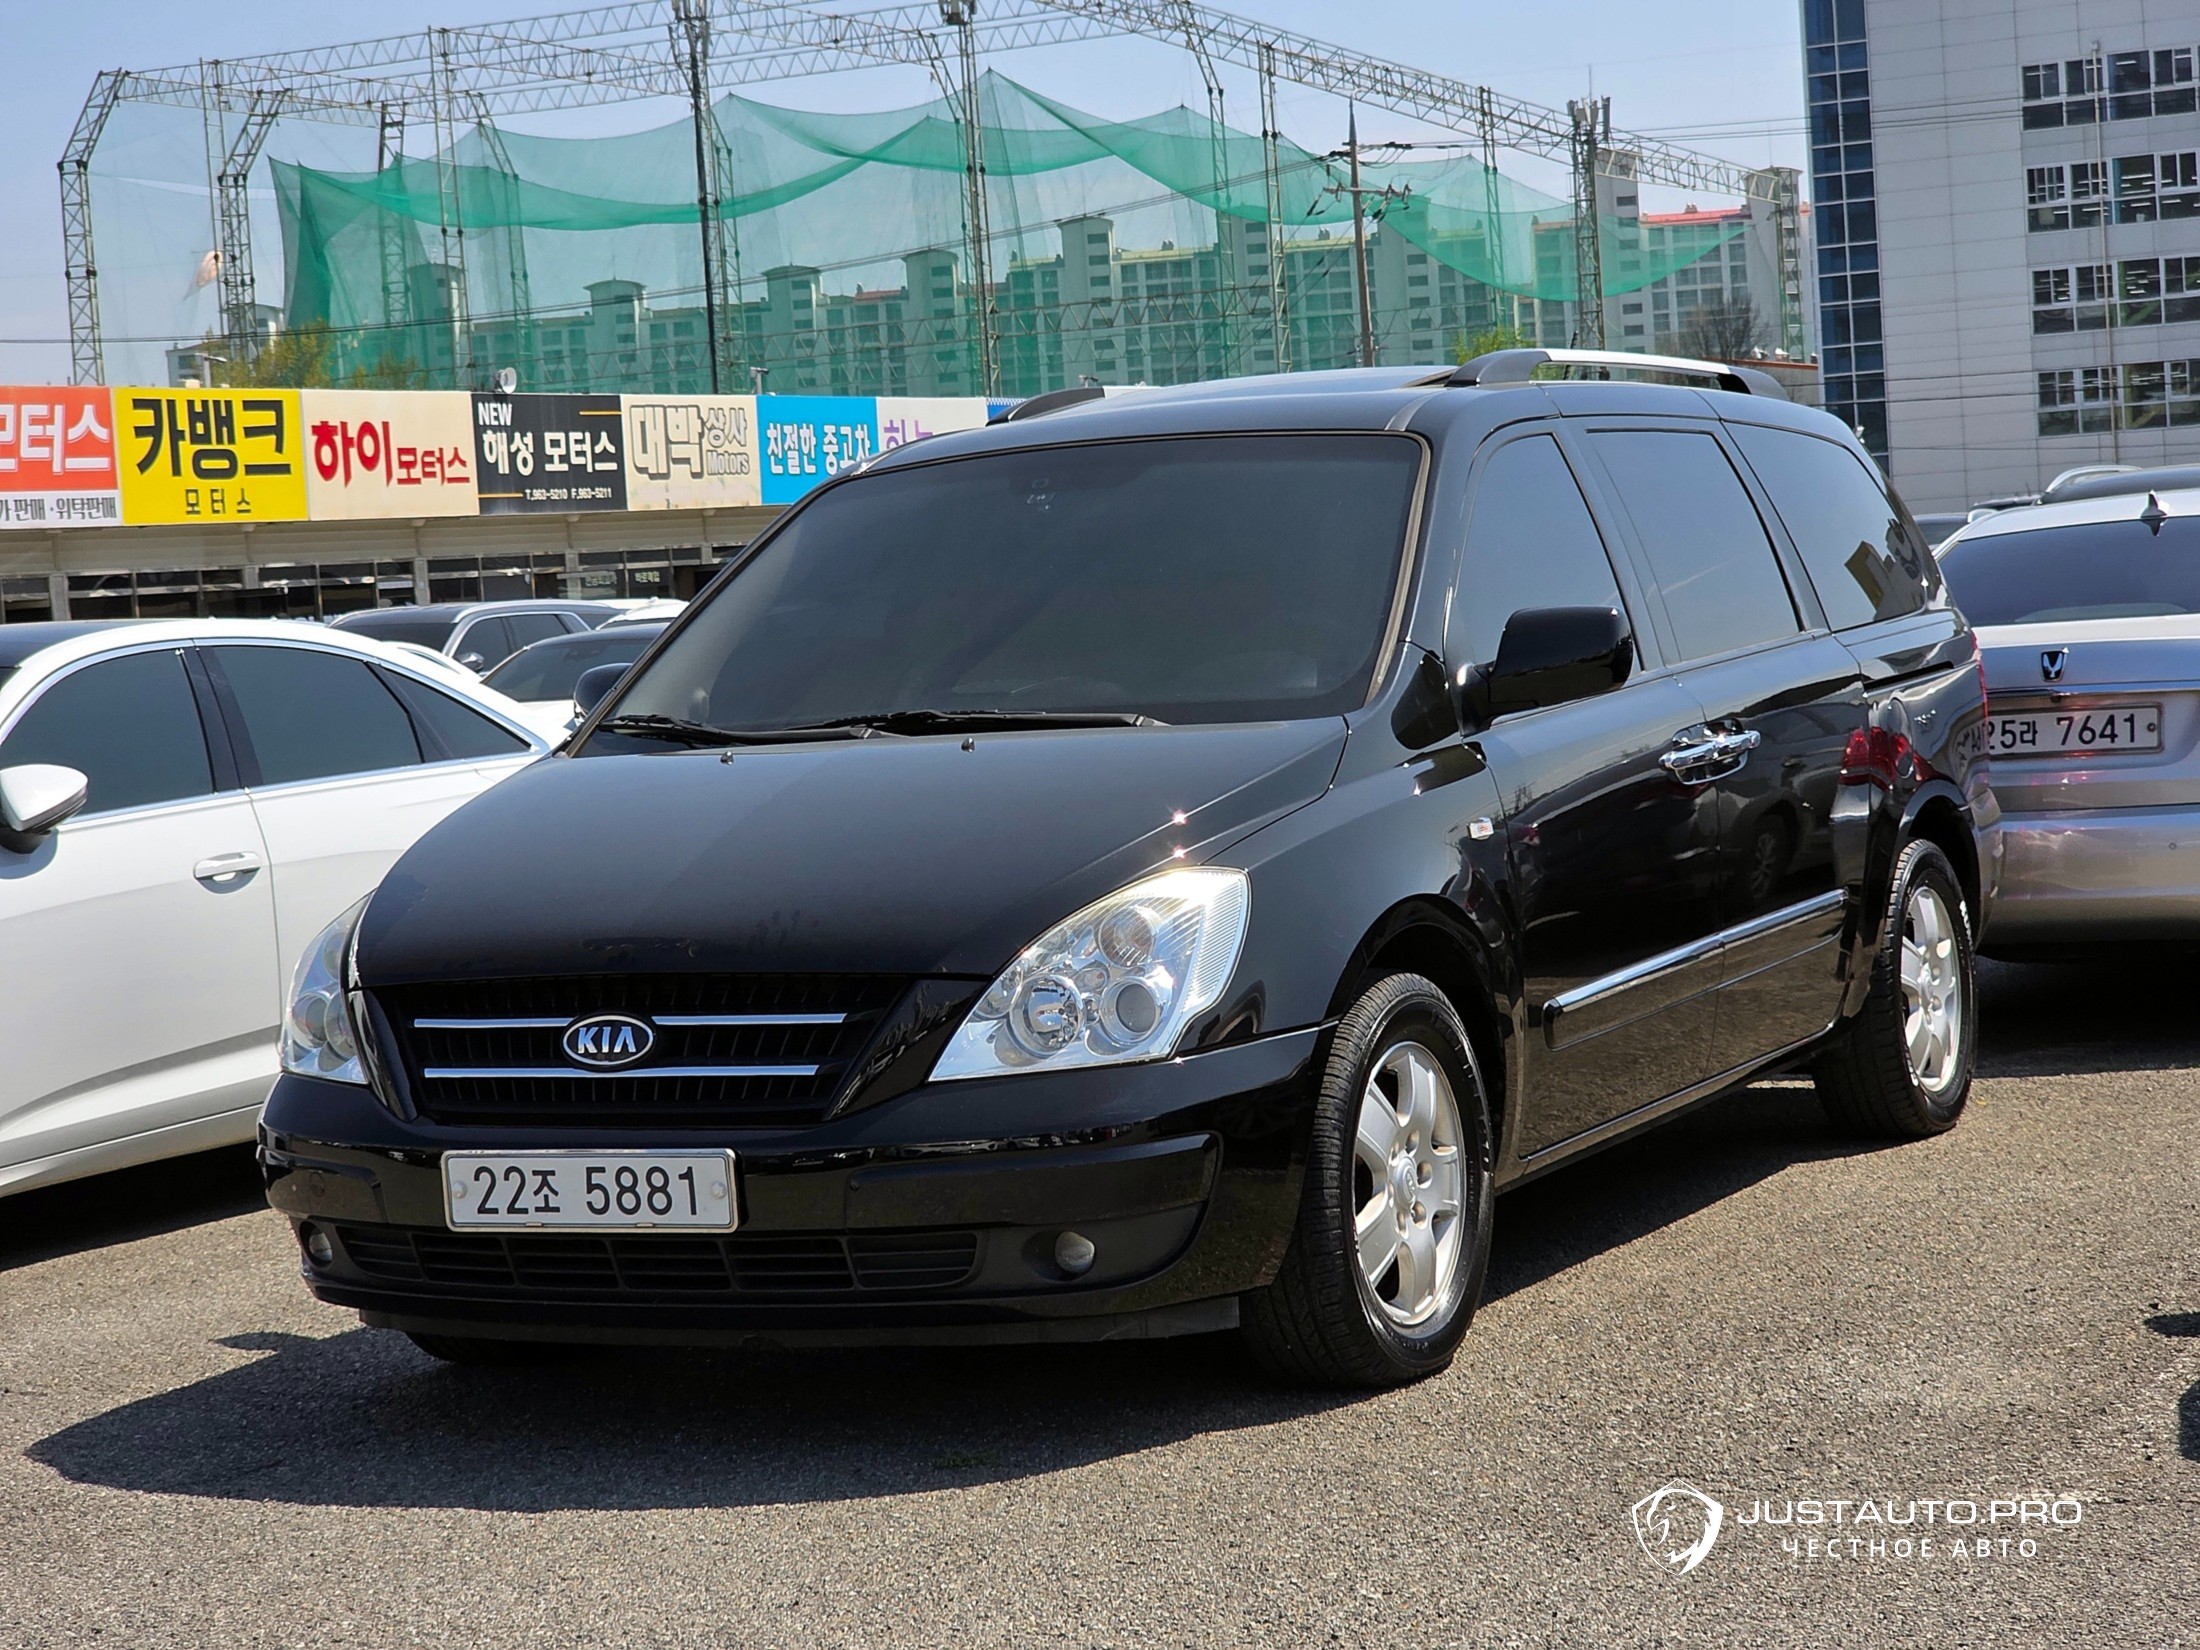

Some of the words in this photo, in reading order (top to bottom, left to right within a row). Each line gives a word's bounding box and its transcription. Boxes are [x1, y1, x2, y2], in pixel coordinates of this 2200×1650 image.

[478, 402, 512, 426] NEW
[132, 398, 292, 480] 카뱅크
[311, 420, 393, 488] 하이
[396, 446, 470, 486] 모터스
[482, 430, 534, 476] 해성
[544, 431, 618, 473] 모터스
[630, 405, 705, 480] 대박
[705, 407, 748, 448] 상사
[766, 422, 816, 475] 친절한
[822, 424, 871, 475] 중고차
[706, 450, 750, 476] Motors
[185, 488, 252, 515] 모터스
[2056, 713, 2136, 746] 7641
[577, 1026, 637, 1054] KIA
[473, 1166, 561, 1215] 22조
[585, 1166, 698, 1216] 5881
